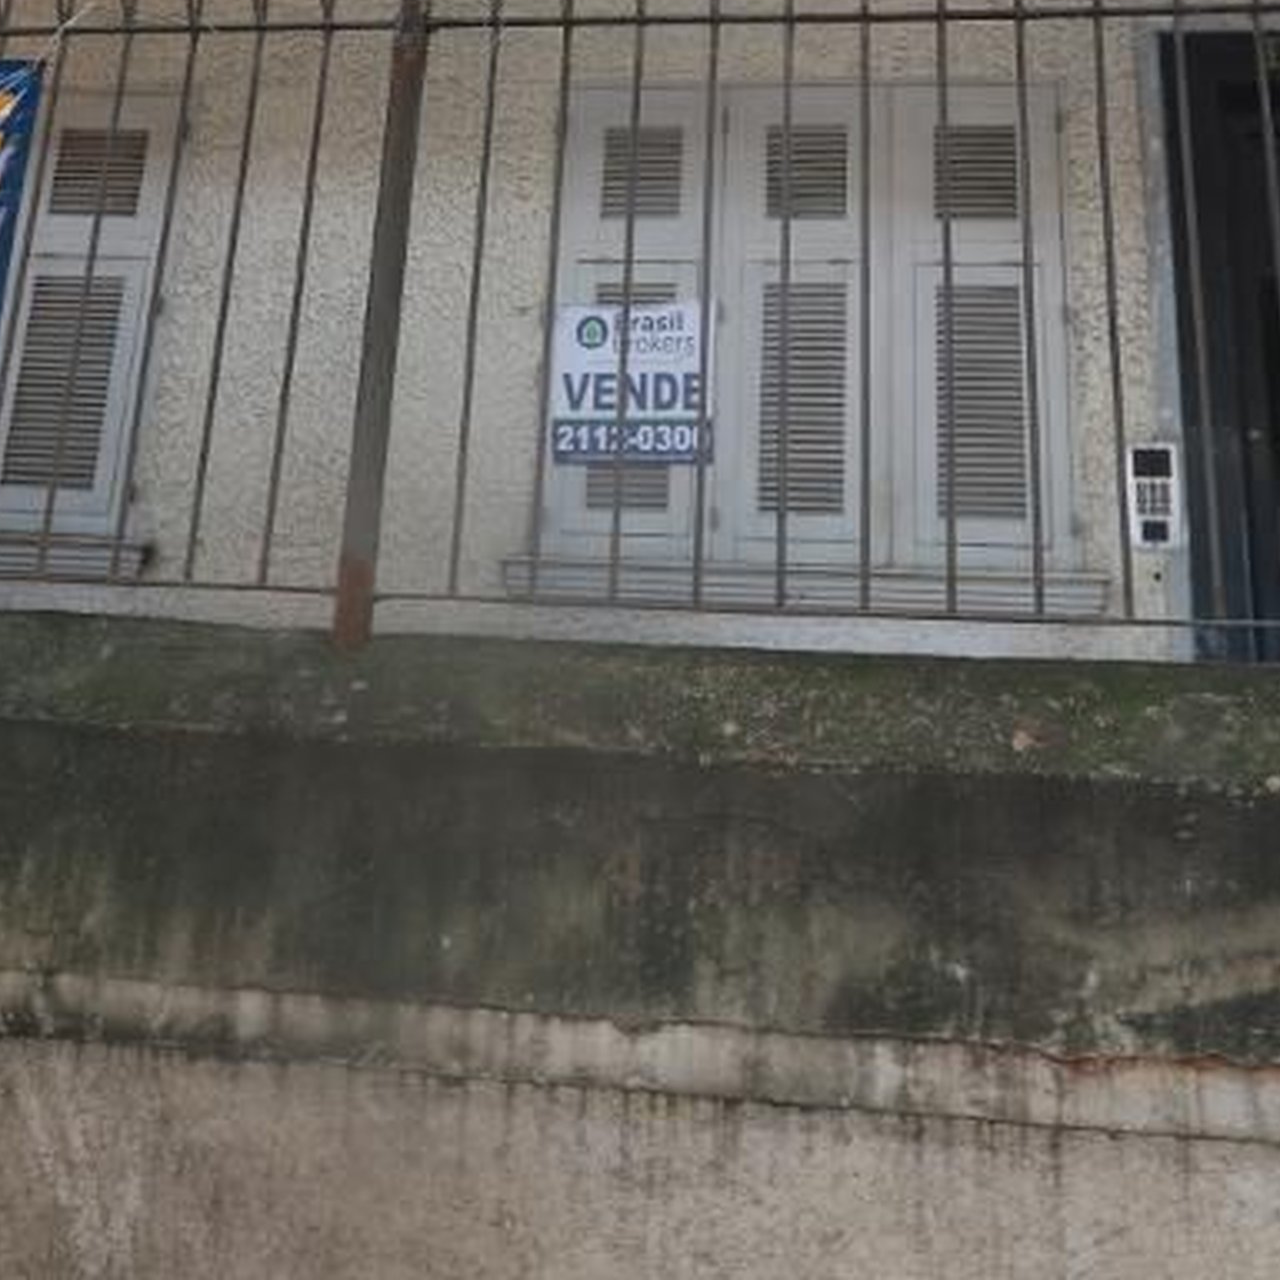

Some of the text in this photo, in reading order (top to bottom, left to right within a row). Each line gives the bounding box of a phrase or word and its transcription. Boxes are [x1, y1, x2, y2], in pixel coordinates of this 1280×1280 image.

[613, 334, 695, 356] okers
[562, 372, 702, 411] VENDE
[556, 425, 700, 451] 211-030
